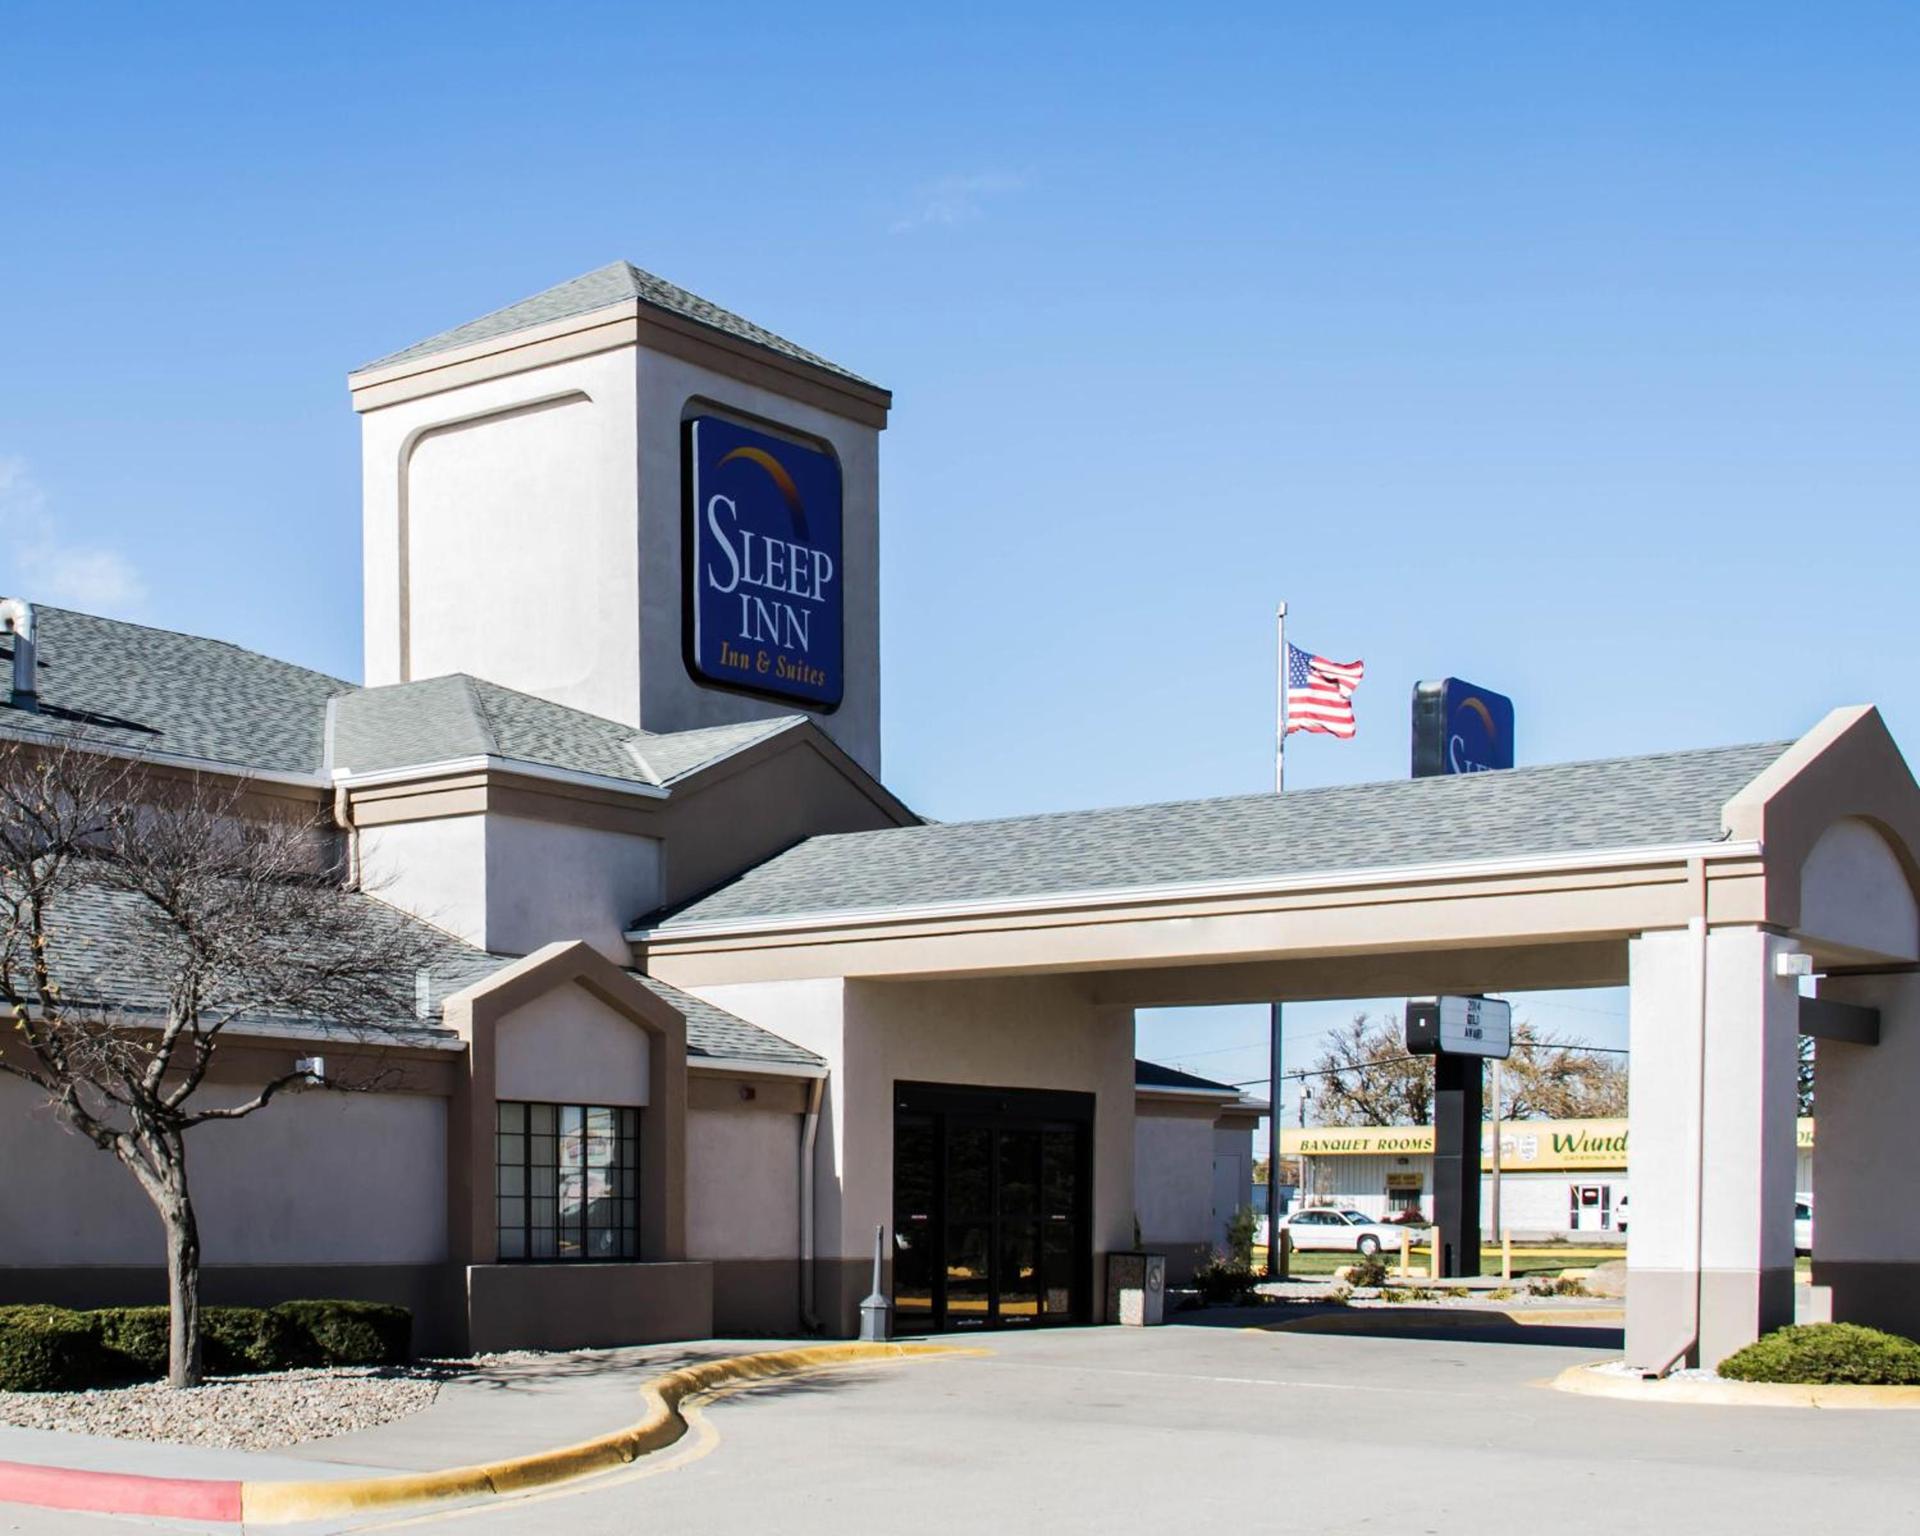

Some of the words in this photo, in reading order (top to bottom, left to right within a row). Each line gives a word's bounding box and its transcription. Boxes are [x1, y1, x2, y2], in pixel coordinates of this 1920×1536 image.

[707, 494, 833, 601] SLEEP
[739, 593, 811, 652] INN
[720, 641, 749, 669] Inn
[755, 652, 770, 676] &
[776, 656, 826, 687] Suites
[1300, 1139, 1370, 1151] BANQUET
[1377, 1137, 1432, 1150] ROOMS
[1552, 1129, 1629, 1153] Wund
